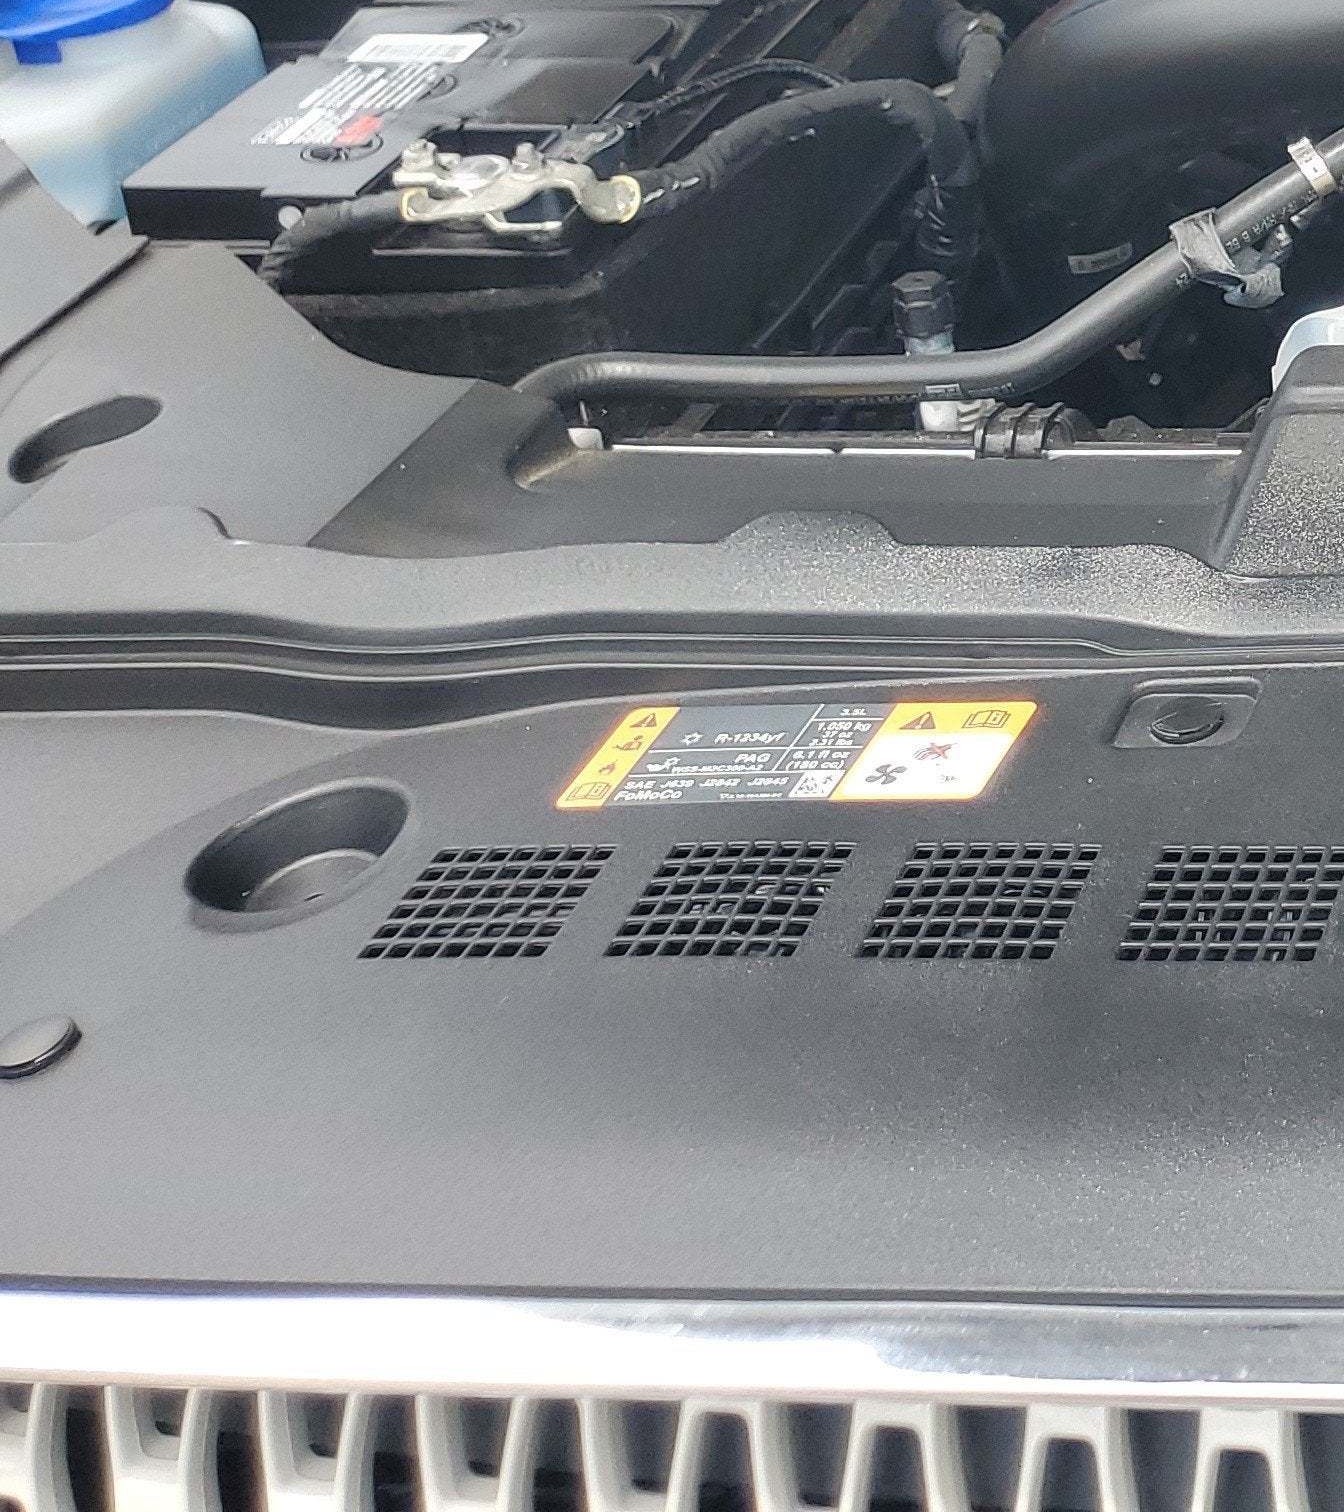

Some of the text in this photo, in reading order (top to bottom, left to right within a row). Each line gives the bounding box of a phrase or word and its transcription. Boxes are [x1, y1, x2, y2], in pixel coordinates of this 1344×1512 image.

[839, 708, 868, 717] 3.5L
[816, 721, 872, 733] 1.050 kg
[714, 732, 789, 746] R-1234yf
[734, 753, 772, 764] PAG
[791, 749, 851, 760] 6.1 fl oz
[819, 760, 846, 771] cc)
[624, 780, 658, 790] SAE
[660, 779, 695, 788] J639
[613, 789, 684, 802] FoMoCo
